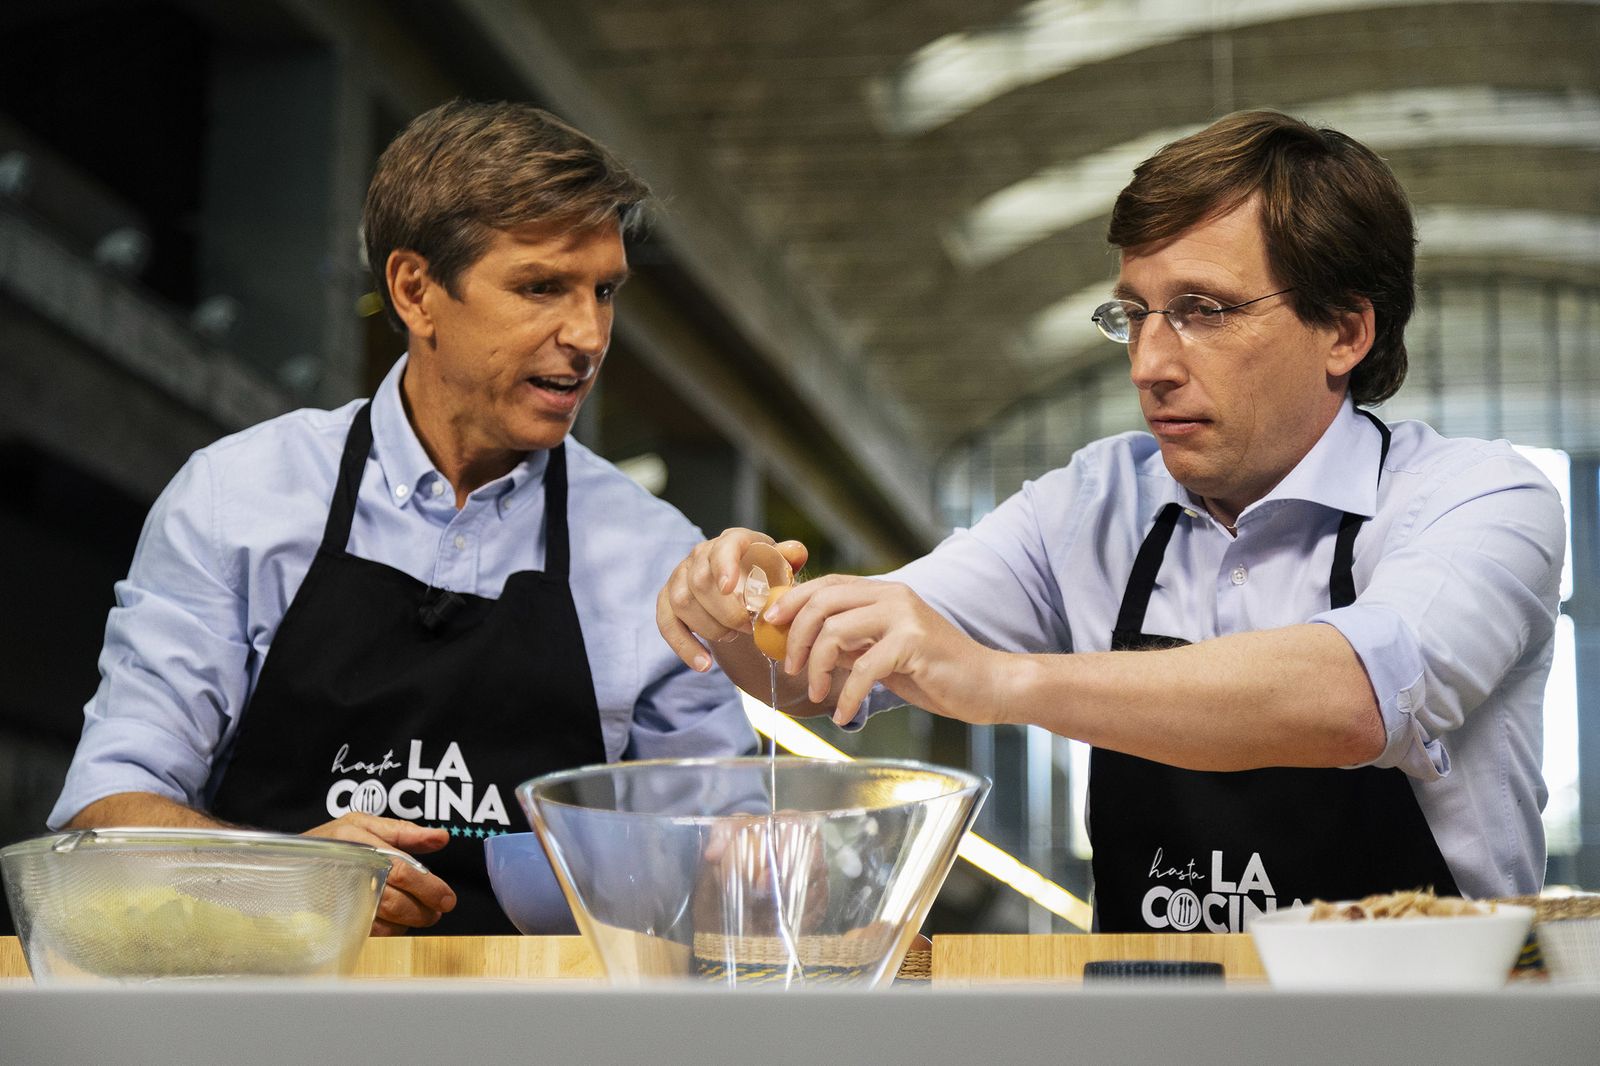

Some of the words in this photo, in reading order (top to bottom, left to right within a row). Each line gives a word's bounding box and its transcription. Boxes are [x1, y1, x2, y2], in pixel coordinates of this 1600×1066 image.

[331, 743, 402, 777] hasta
[407, 739, 473, 783] LA
[325, 778, 511, 826] COCINA
[1148, 847, 1206, 886] hasta
[1211, 850, 1277, 896] LA
